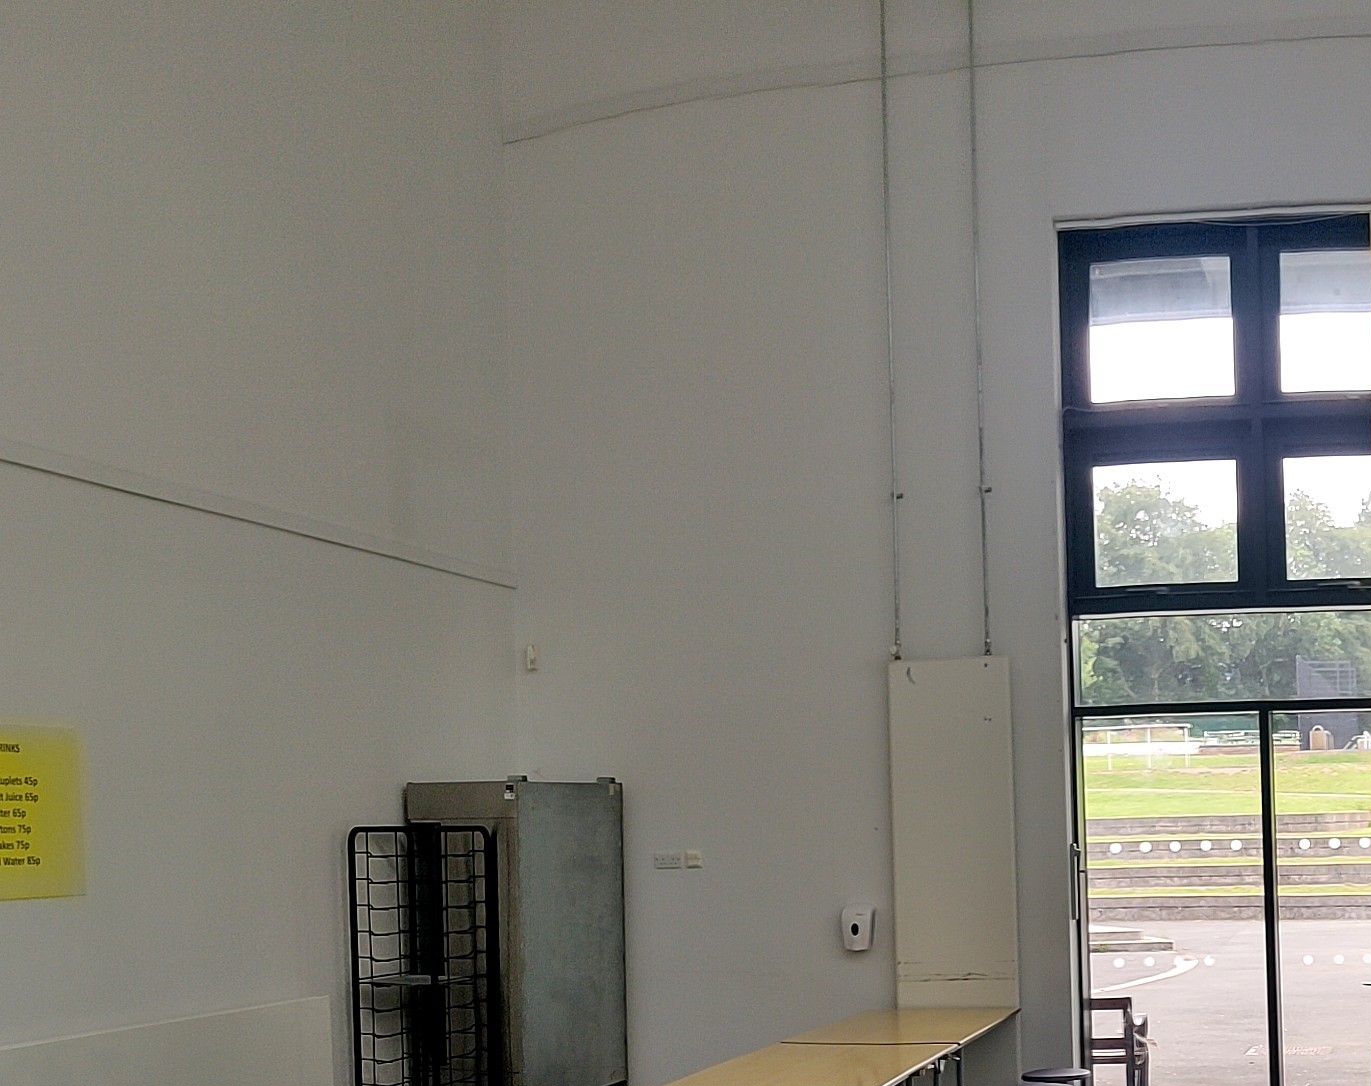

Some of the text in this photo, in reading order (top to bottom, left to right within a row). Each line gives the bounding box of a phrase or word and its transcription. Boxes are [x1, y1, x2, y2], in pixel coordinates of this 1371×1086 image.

[24, 777, 38, 787] 45p
[5, 792, 23, 801] Juice
[25, 792, 39, 803] 65p
[12, 808, 27, 819] 65p
[17, 824, 32, 834] 75p
[15, 840, 30, 851] 75p
[3, 857, 25, 866] Water
